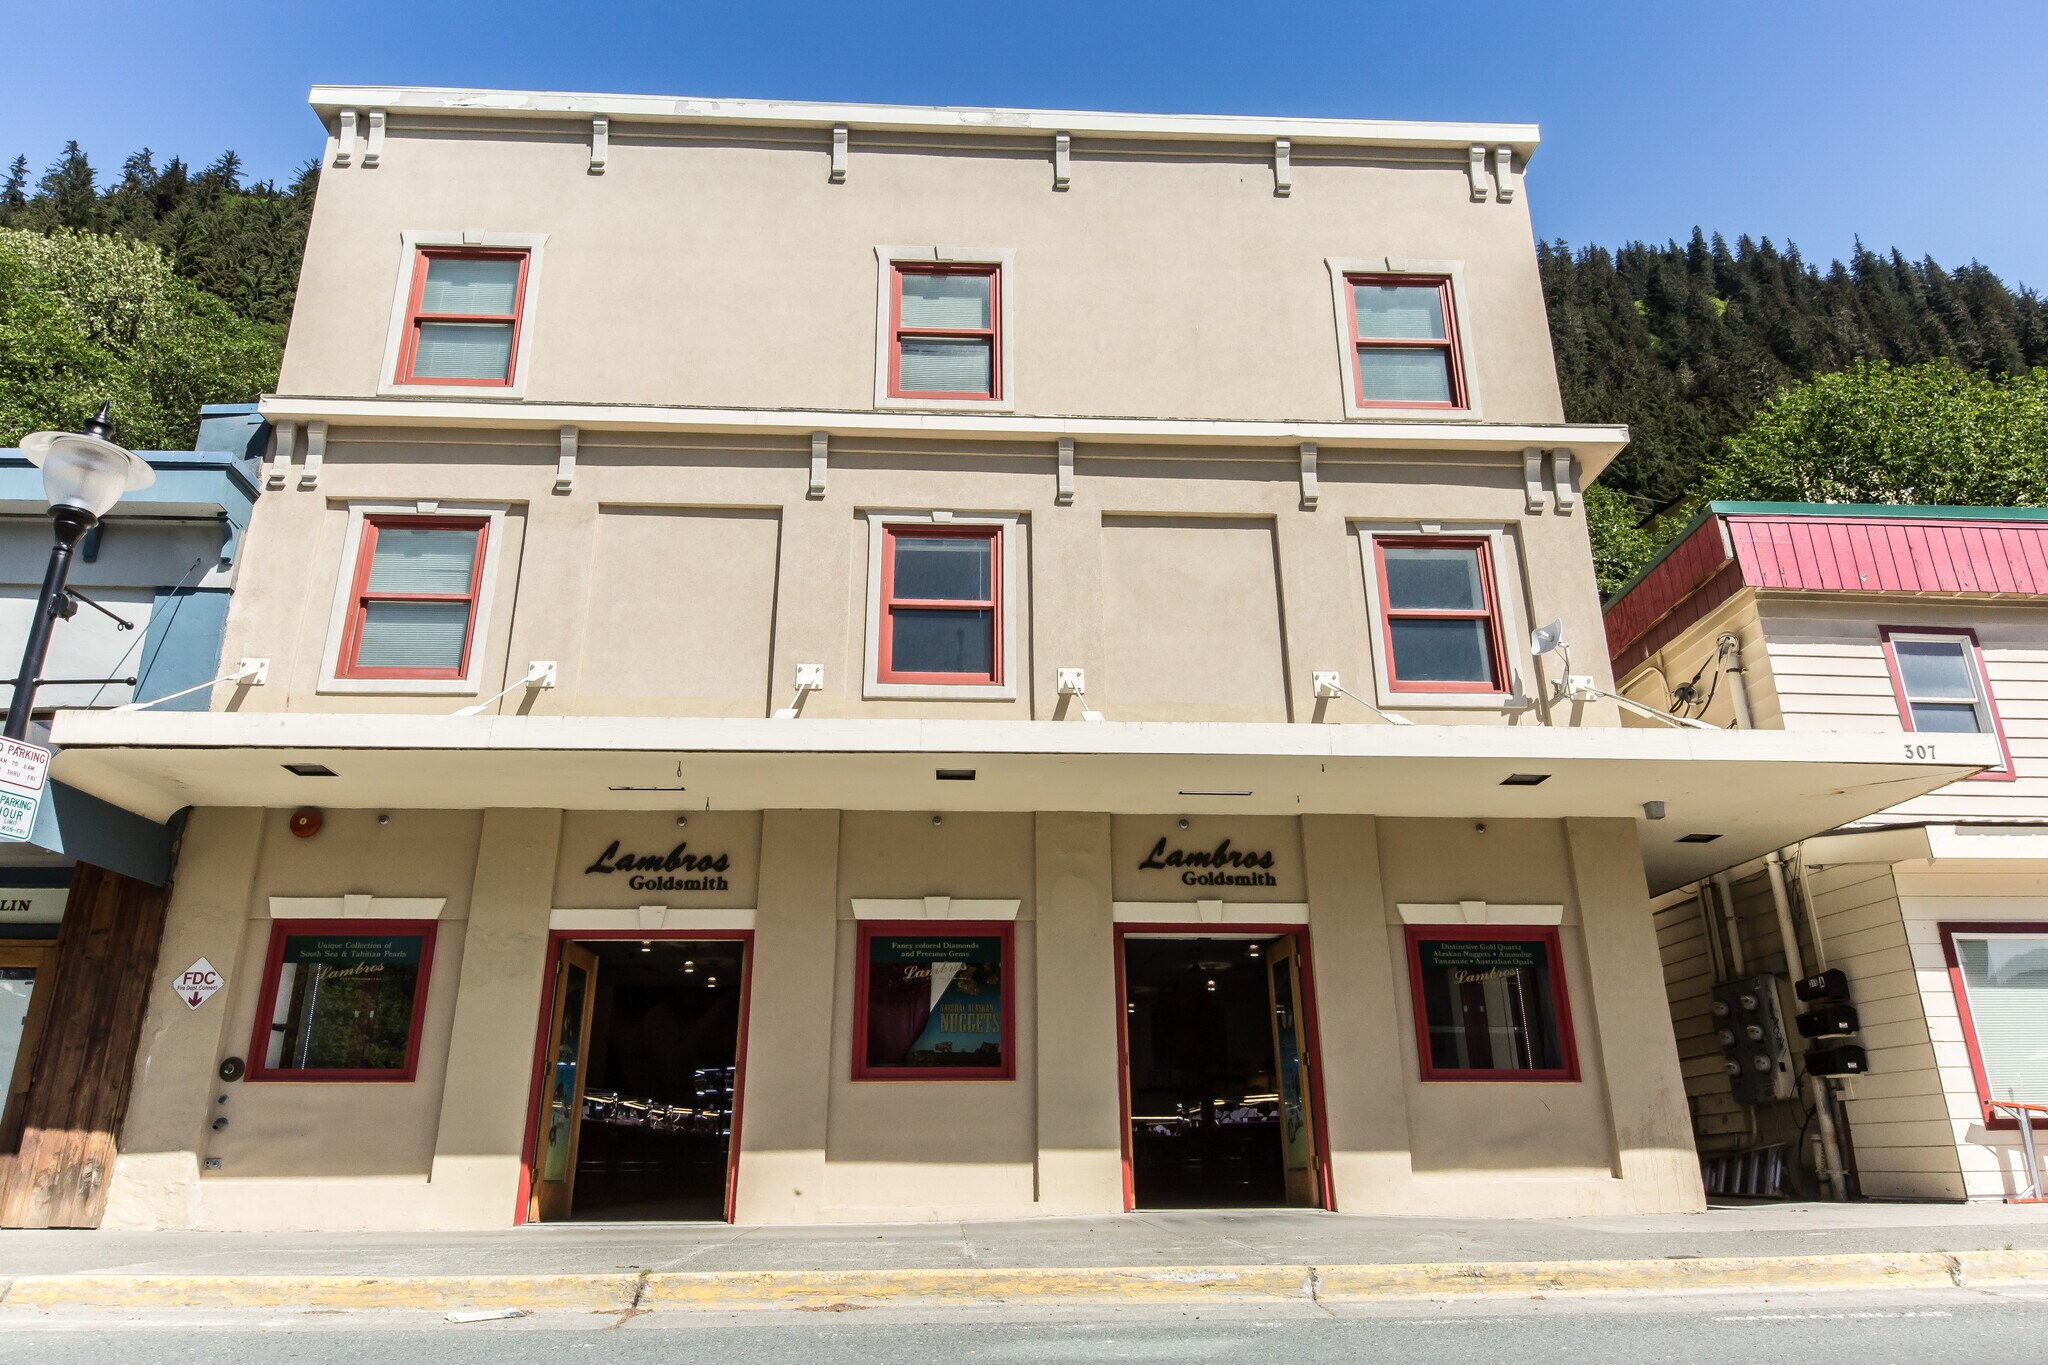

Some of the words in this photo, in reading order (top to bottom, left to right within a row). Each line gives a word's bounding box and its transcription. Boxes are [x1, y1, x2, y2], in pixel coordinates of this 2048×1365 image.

[7, 745, 45, 764] PARKING
[1904, 744, 1936, 760] 307
[7, 770, 20, 778] THRU
[0, 795, 32, 811] PARKING
[584, 839, 730, 875] Lambros
[1138, 836, 1275, 870] Lambros
[629, 875, 729, 891] Goldsmith
[1181, 870, 1277, 886] Goldsmith
[300, 950, 321, 958] South
[324, 950, 338, 958] Sea
[341, 950, 347, 958] &
[351, 950, 381, 958] Tahitian
[384, 950, 407, 958] Pearls
[317, 941, 343, 951] Unique
[345, 941, 382, 949] Collection
[384, 941, 393, 949] of
[892, 942, 913, 950] Fancy
[1497, 943, 1522, 952] Quartz
[1463, 950, 1491, 959] Nuggets
[1513, 958, 1534, 966] Opals
[183, 971, 216, 985] FDC
[320, 961, 385, 981] Lambros
[903, 961, 968, 981] Lambros
[1454, 966, 1516, 985] Lambros
[940, 1013, 1000, 1033] NUGGETS
